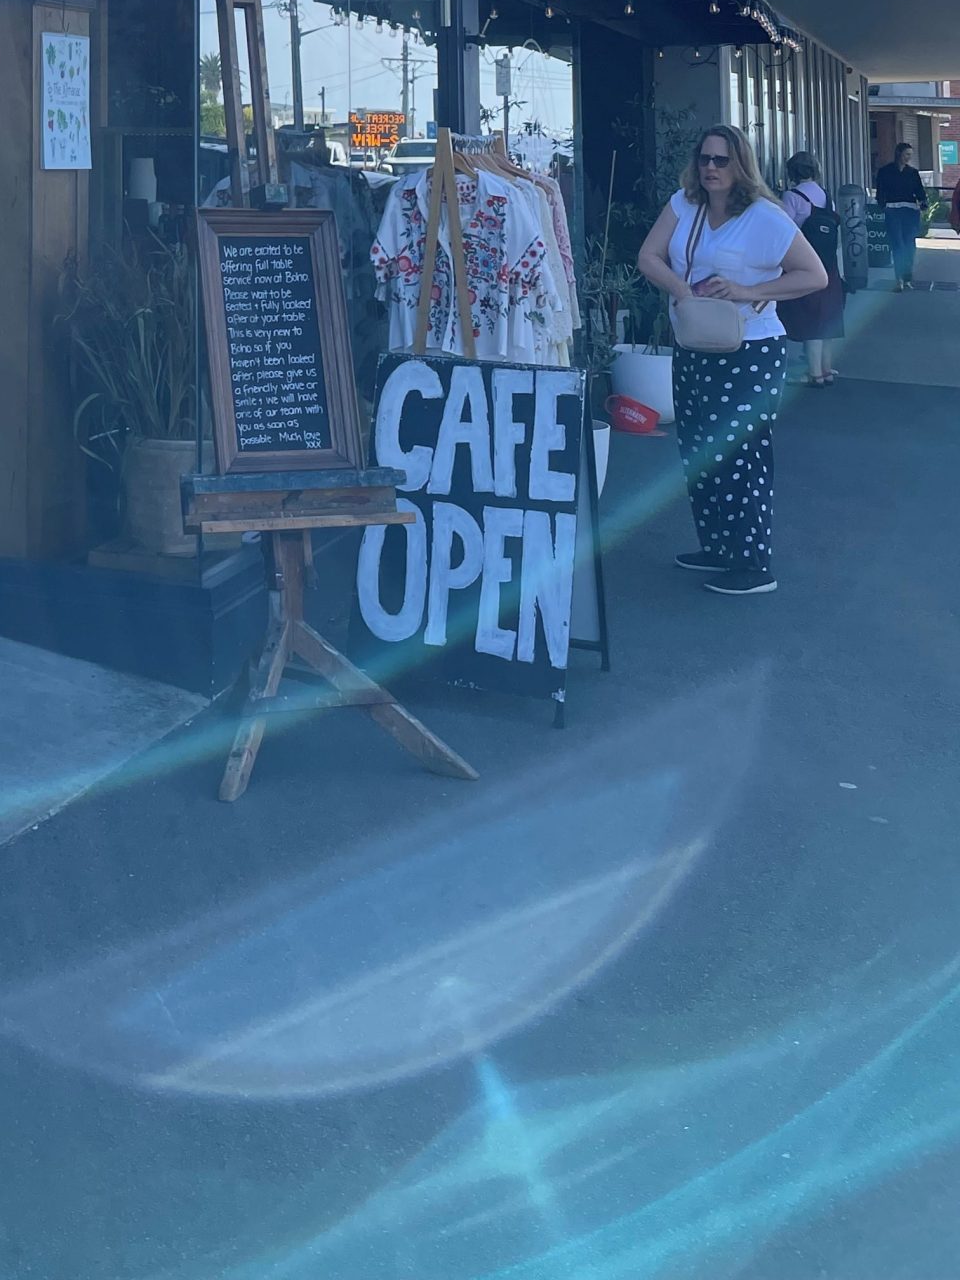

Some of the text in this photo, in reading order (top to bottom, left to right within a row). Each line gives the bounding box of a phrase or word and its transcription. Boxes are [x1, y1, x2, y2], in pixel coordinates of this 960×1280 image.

[865, 230, 886, 238] ow
[224, 244, 304, 258] We are excited to be
[220, 259, 293, 276] offering full table
[223, 276, 251, 285] service
[255, 275, 272, 284] now
[274, 272, 282, 283] at
[224, 288, 292, 301] Please wait to be
[260, 300, 279, 312] fully
[282, 298, 311, 310] looked
[227, 314, 248, 324] after
[250, 314, 259, 323] at
[261, 314, 280, 327] your
[228, 328, 244, 338] This
[246, 328, 252, 337] is
[254, 329, 271, 340] very
[292, 326, 302, 336] to
[230, 341, 292, 354] Boho so if you
[263, 356, 285, 366] been
[288, 353, 315, 364] looked
[256, 370, 283, 383] please
[286, 369, 303, 383] give
[306, 368, 317, 377] us
[243, 382, 278, 396] friendly
[281, 382, 305, 390] wave
[306, 382, 318, 390] or
[235, 398, 256, 407] smile
[266, 396, 278, 404] we
[281, 393, 295, 403] will
[297, 392, 318, 402] have
[236, 404, 323, 419] one of our team with
[237, 423, 251, 436] you
[287, 419, 299, 428] as
[375, 360, 580, 502] CAFE
[240, 430, 320, 450] possible Much love
[357, 498, 577, 669] OPEN
